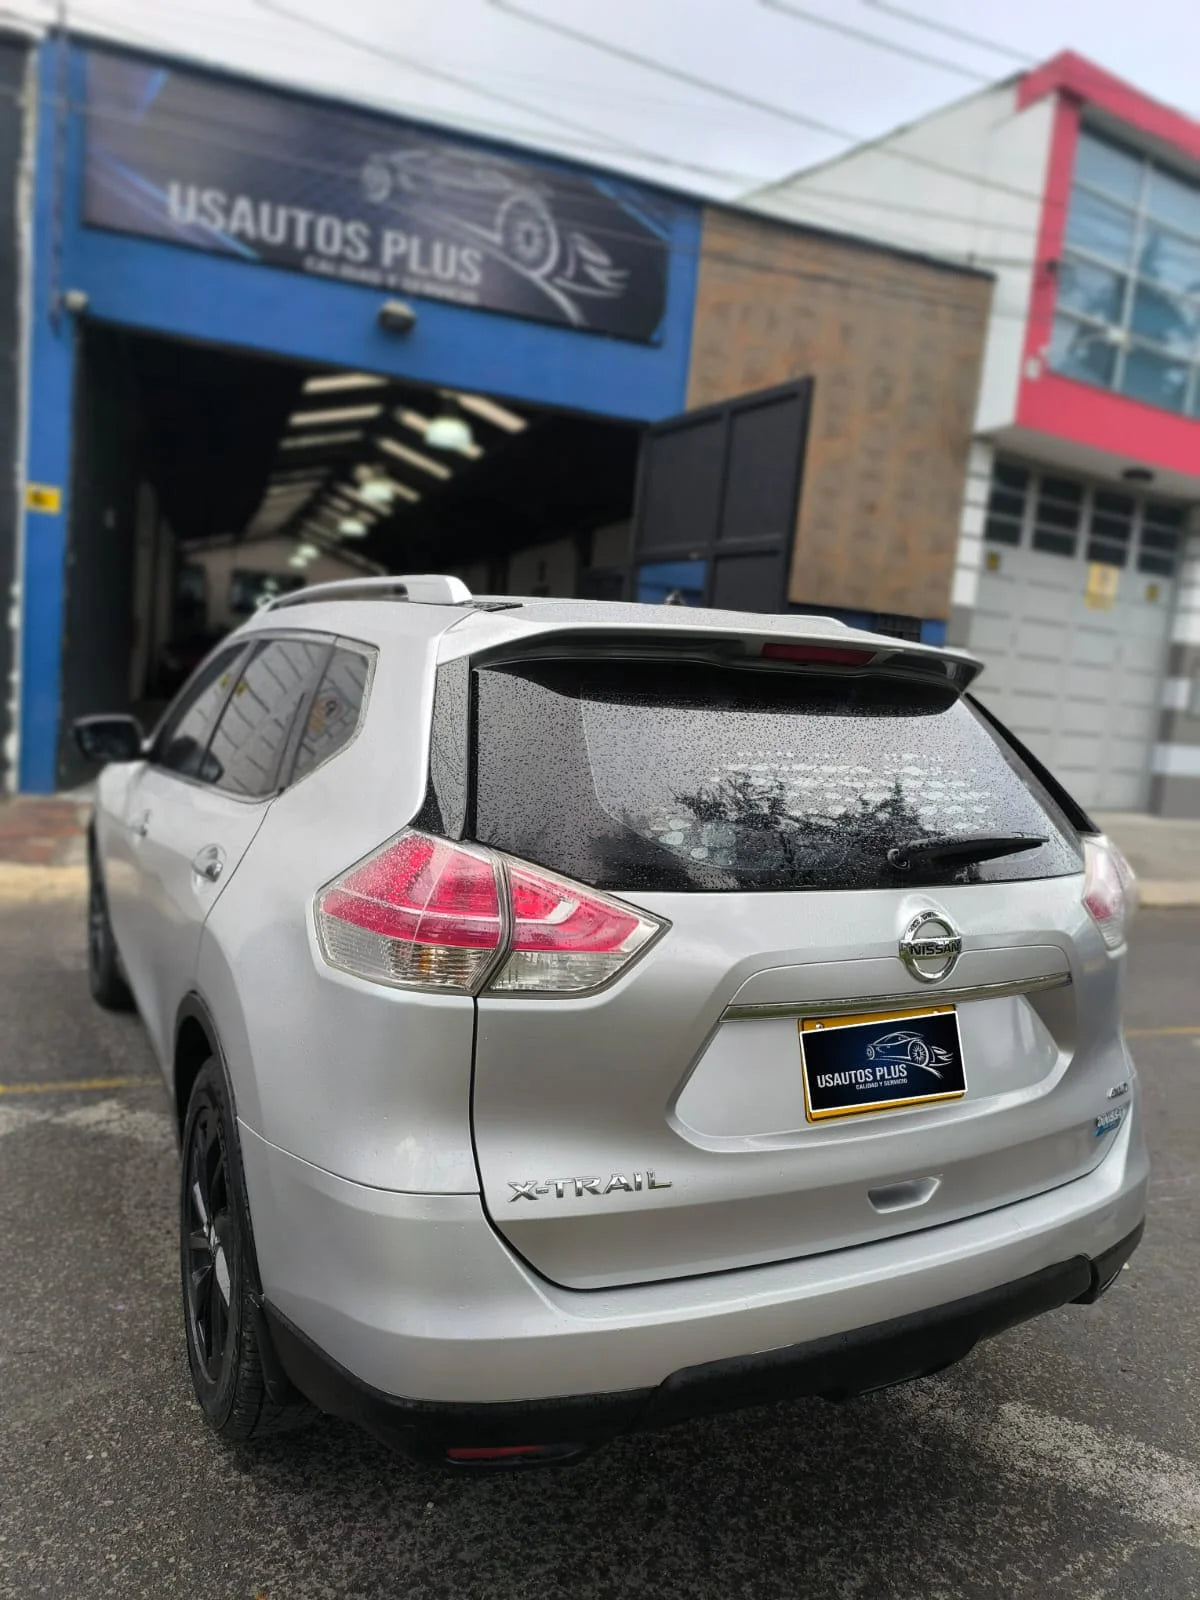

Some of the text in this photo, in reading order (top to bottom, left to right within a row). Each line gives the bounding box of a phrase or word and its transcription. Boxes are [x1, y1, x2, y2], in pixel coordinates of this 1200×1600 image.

[167, 181, 484, 287] USAUTOS PLUS
[910, 939, 961, 956] NISSAN
[507, 1168, 673, 1202] X-TRAIL
